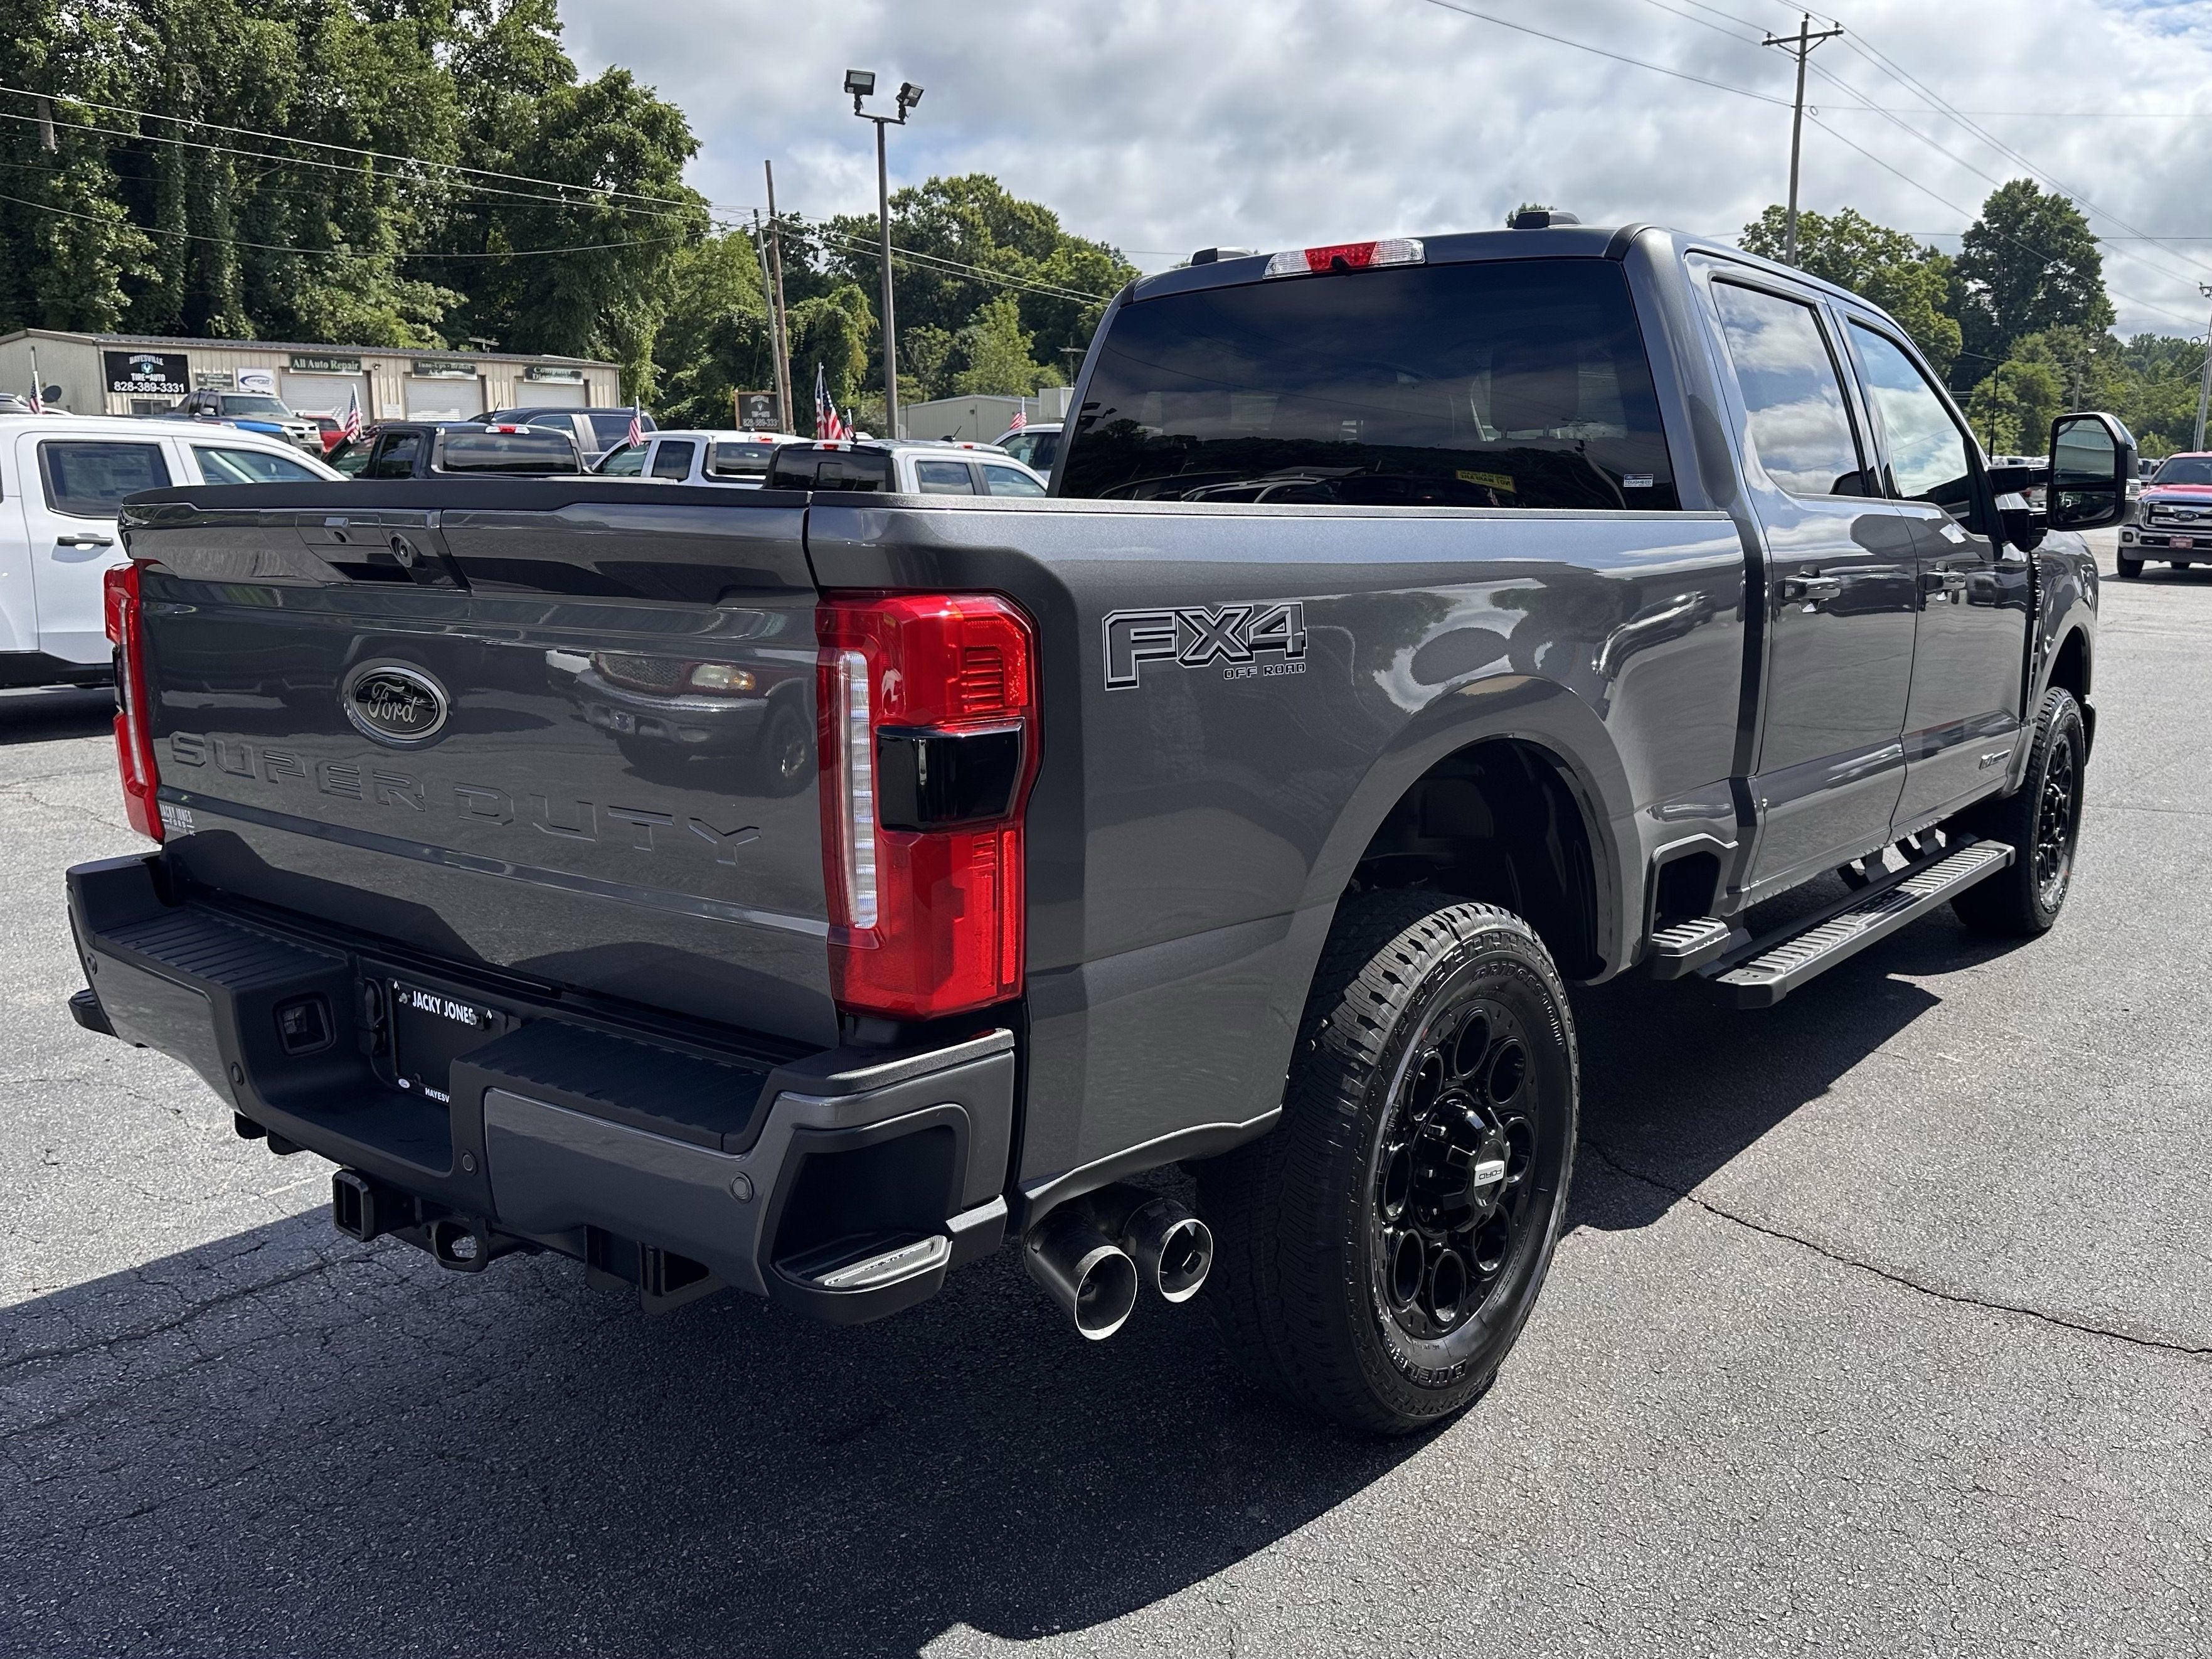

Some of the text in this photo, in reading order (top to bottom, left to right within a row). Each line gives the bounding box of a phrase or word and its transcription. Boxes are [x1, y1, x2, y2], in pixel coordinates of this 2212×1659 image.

[293, 358, 359, 373] All Auto Repair
[114, 381, 184, 393] 828-389-3331
[1101, 602, 1308, 691] FX4
[1223, 662, 1305, 680] OFF ROAD
[368, 681, 417, 723] Ford
[169, 731, 761, 865] SUPER DUTY
[169, 818, 186, 828] FORD
[412, 990, 441, 1015] JACKY
[425, 1087, 450, 1103] HAYESV
[1479, 1168, 1502, 1180] FORD
